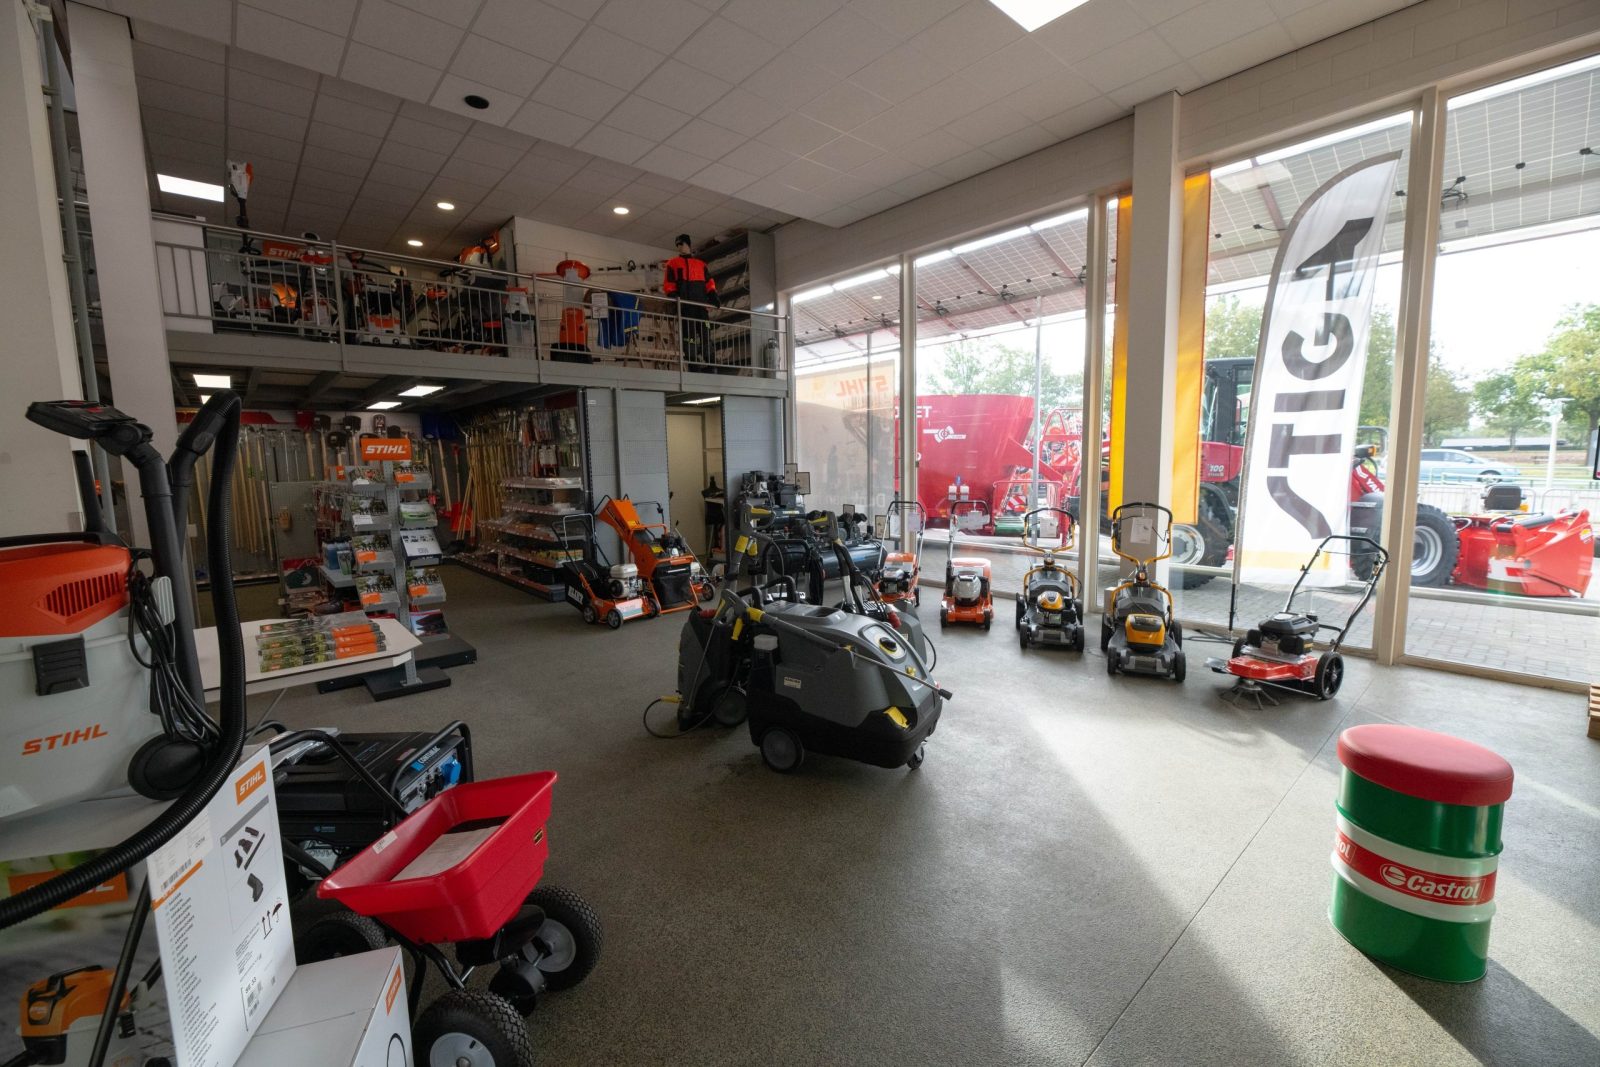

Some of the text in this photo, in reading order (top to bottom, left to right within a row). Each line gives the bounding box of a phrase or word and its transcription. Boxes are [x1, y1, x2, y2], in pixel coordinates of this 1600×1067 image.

[365, 445, 406, 454] STIHL
[22, 723, 108, 755] STIHL
[239, 771, 263, 795] STIHL
[1407, 874, 1482, 899] Castrol
